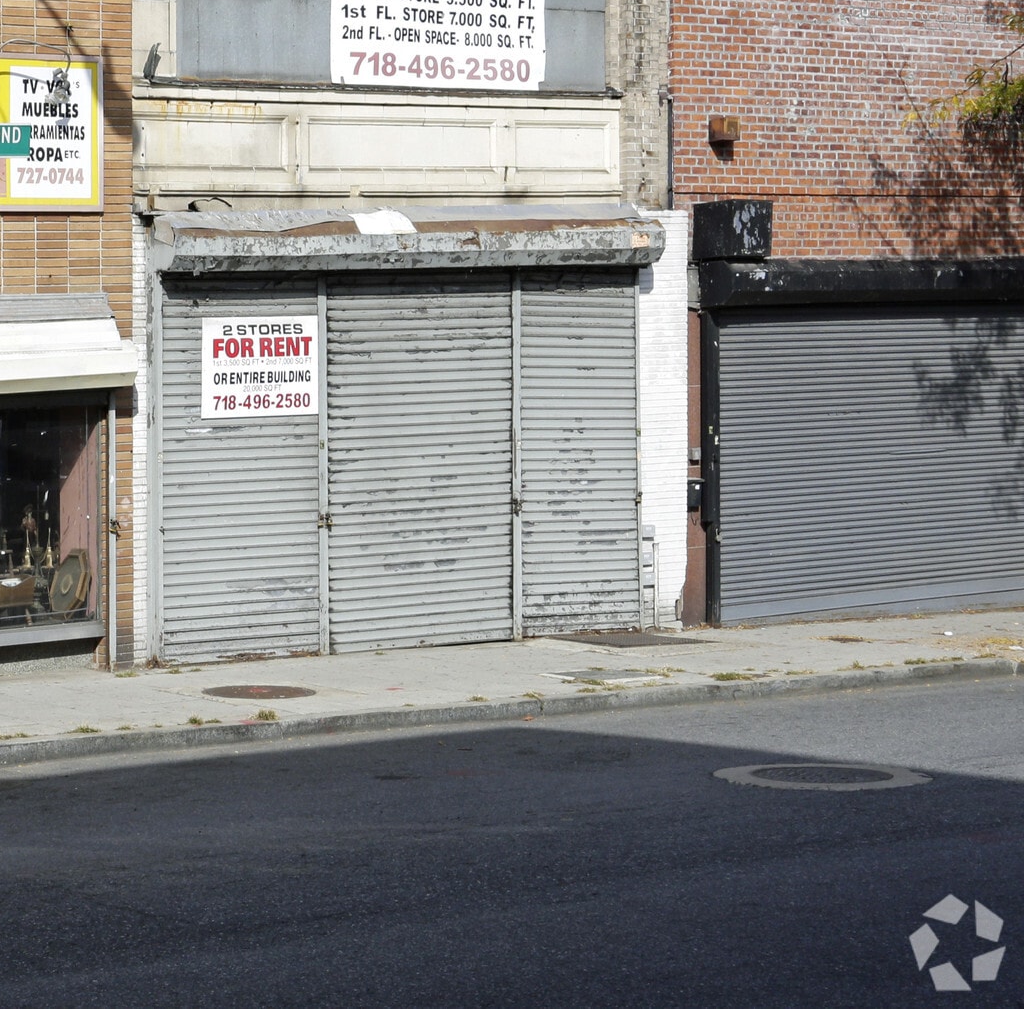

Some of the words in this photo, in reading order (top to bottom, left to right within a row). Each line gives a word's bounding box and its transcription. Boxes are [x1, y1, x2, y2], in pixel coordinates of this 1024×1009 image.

[341, 4, 366, 18] 1st
[376, 6, 396, 20] FL.
[403, 7, 443, 25] STORE
[449, 12, 482, 27] 7.000
[489, 14, 511, 29] SQ.
[518, 15, 535, 31] FT.
[342, 25, 363, 40] 2nd
[464, 33, 492, 47] 8.000
[497, 34, 514, 49] SQ.
[519, 35, 534, 49] FT.
[349, 51, 531, 83] 718-496-2580
[22, 79, 38, 94] TV
[22, 102, 79, 118] MUEBLES
[27, 147, 63, 162] ROPA
[17, 168, 84, 185] 727-0744
[223, 325, 233, 336] 2
[237, 324, 303, 336] STORES
[213, 338, 254, 359] FOR
[259, 336, 313, 357] RENT
[241, 358, 251, 366] SQ
[295, 357, 304, 365] SQ
[213, 372, 228, 385] OR
[229, 371, 265, 385] ENTIRE
[267, 370, 311, 383] BUILDING
[213, 393, 311, 411] 718-496-2580
